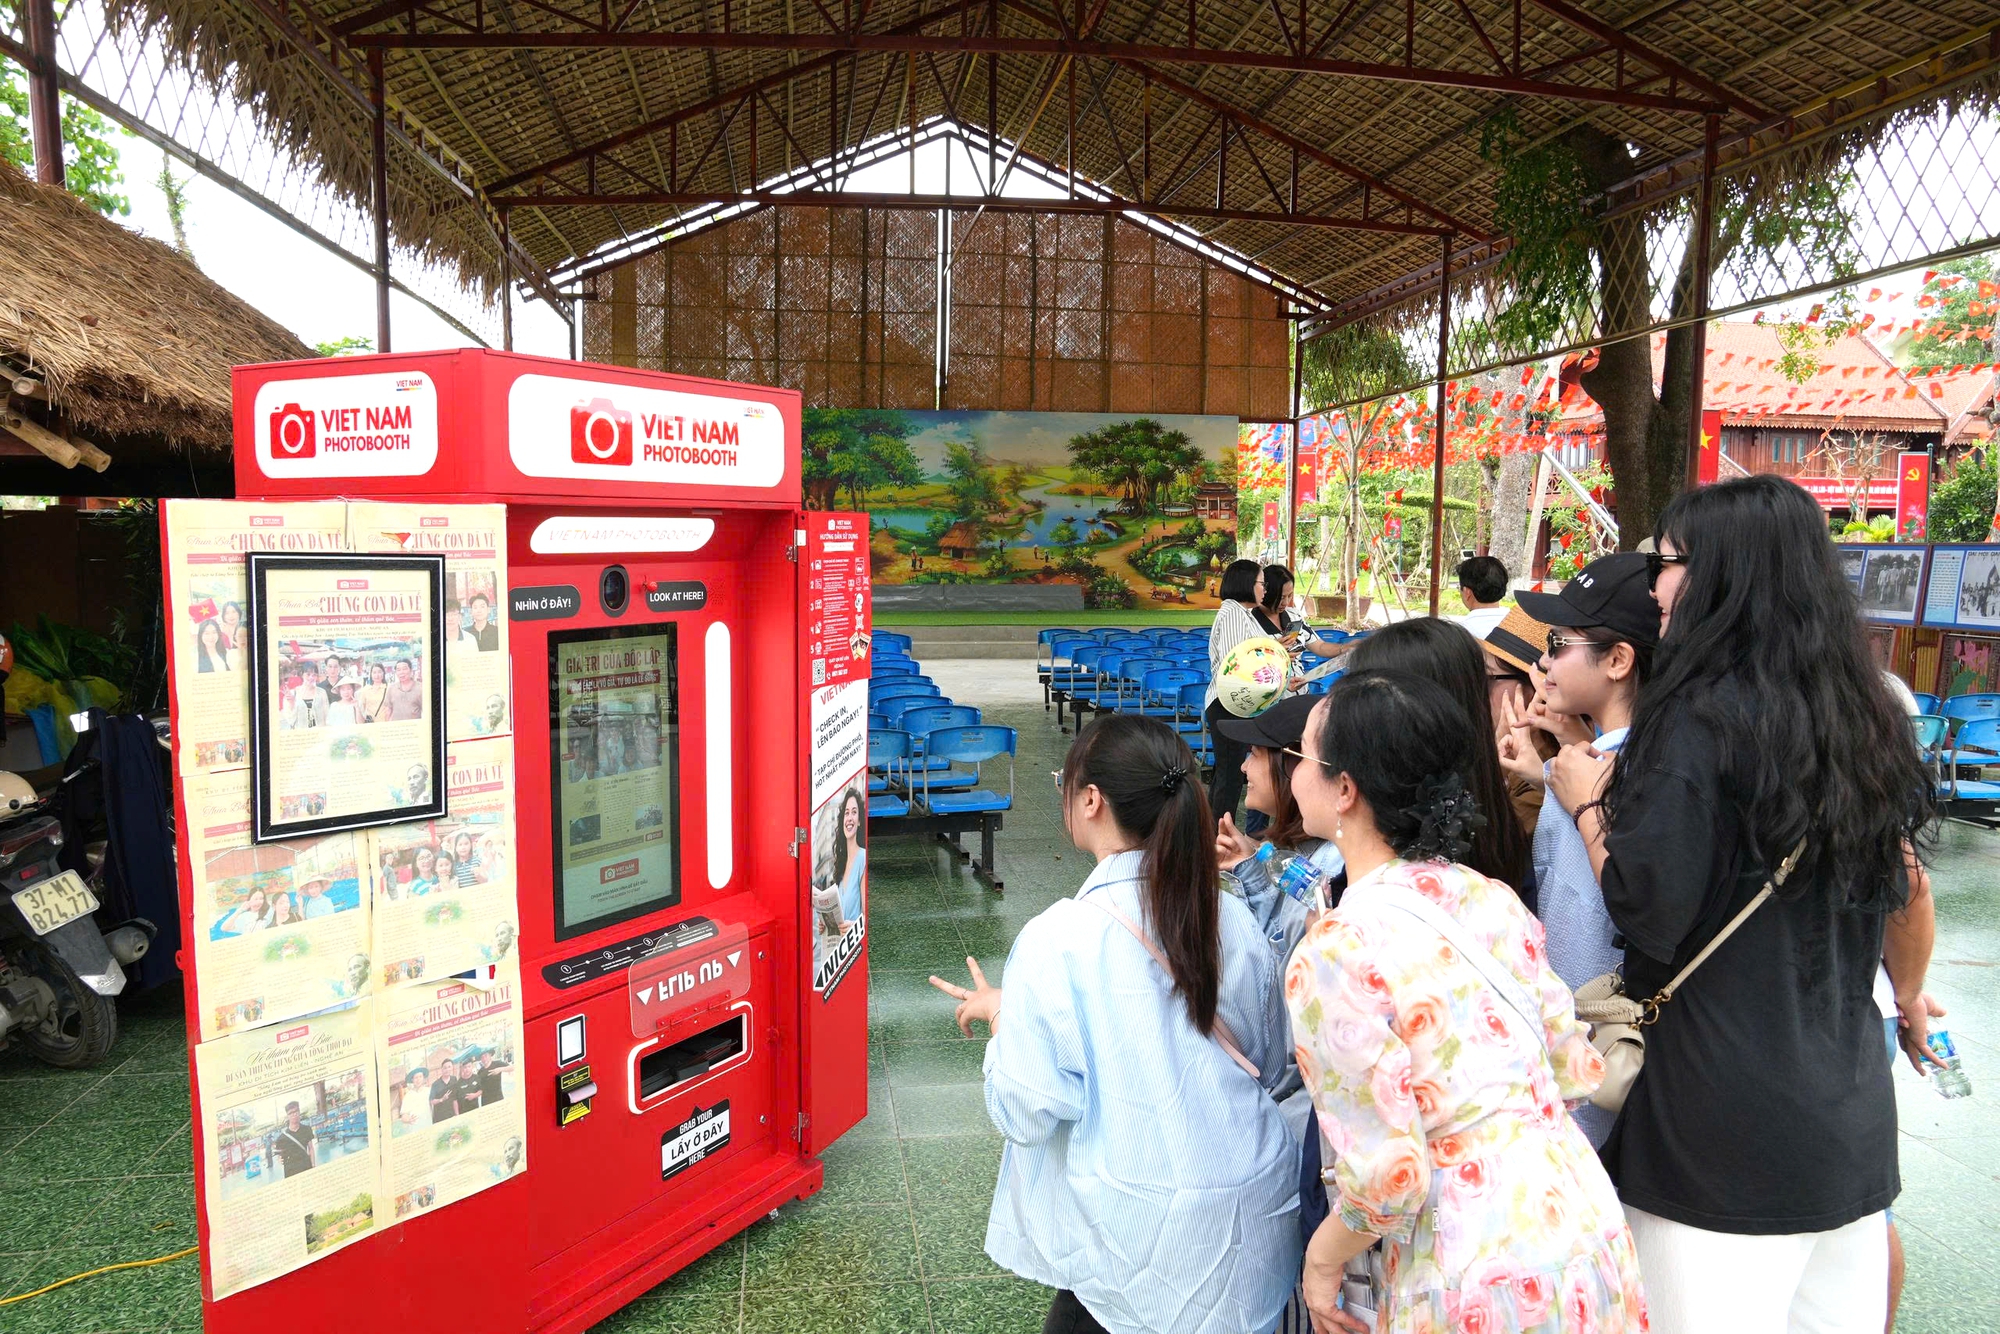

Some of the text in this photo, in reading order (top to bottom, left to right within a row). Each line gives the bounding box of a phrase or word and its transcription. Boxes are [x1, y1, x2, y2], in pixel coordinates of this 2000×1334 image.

[396, 380, 408, 388] VIET
[321, 406, 412, 432] VIET NAM
[640, 413, 739, 446] VIET NAM
[324, 434, 410, 452] PHOTOBOOTH
[644, 444, 737, 466] PHOTOBOOTH
[230, 530, 276, 550] CHÚNG
[280, 533, 304, 550] CON
[411, 530, 441, 549] HÚNG
[444, 532, 464, 548] CON
[550, 530, 701, 540] VIETNAM PHOTOBOOTH
[810, 562, 814, 571] 1
[810, 580, 814, 590] 2
[320, 594, 360, 614] CHÚNG
[364, 596, 386, 612] CON
[515, 597, 572, 612] NHÌN Ở ĐÂY!
[650, 591, 704, 602] LOOK AT HERE!
[810, 602, 814, 612] 3
[810, 644, 814, 654] 5
[566, 646, 660, 674] GIÁ TRỊ CỦA ĐỘC LẬP
[820, 680, 856, 706] VIETN
[817, 734, 829, 749] LÊN
[829, 725, 842, 740] BÁO
[827, 754, 836, 768] CHÍ
[452, 770, 472, 786] CON
[815, 776, 826, 790] HOT
[826, 765, 838, 783] NHẤT
[838, 754, 850, 771] HÔM
[24, 876, 76, 910] 37-M1
[32, 891, 90, 930] 824.77
[824, 916, 864, 984] NICE!!
[422, 1002, 458, 1024] CHÚNG
[462, 995, 481, 1013] CON
[238, 1078, 253, 1087] KHU
[264, 1070, 280, 1080] TÍCH
[281, 1066, 294, 1074] KIM
[294, 1060, 309, 1070] LIÊN
[334, 1050, 344, 1058] AN
[680, 1109, 712, 1134] GRAB YOUR
[672, 1120, 724, 1160] LẤY Ở ĐÂY
[688, 1148, 706, 1166] HERE
